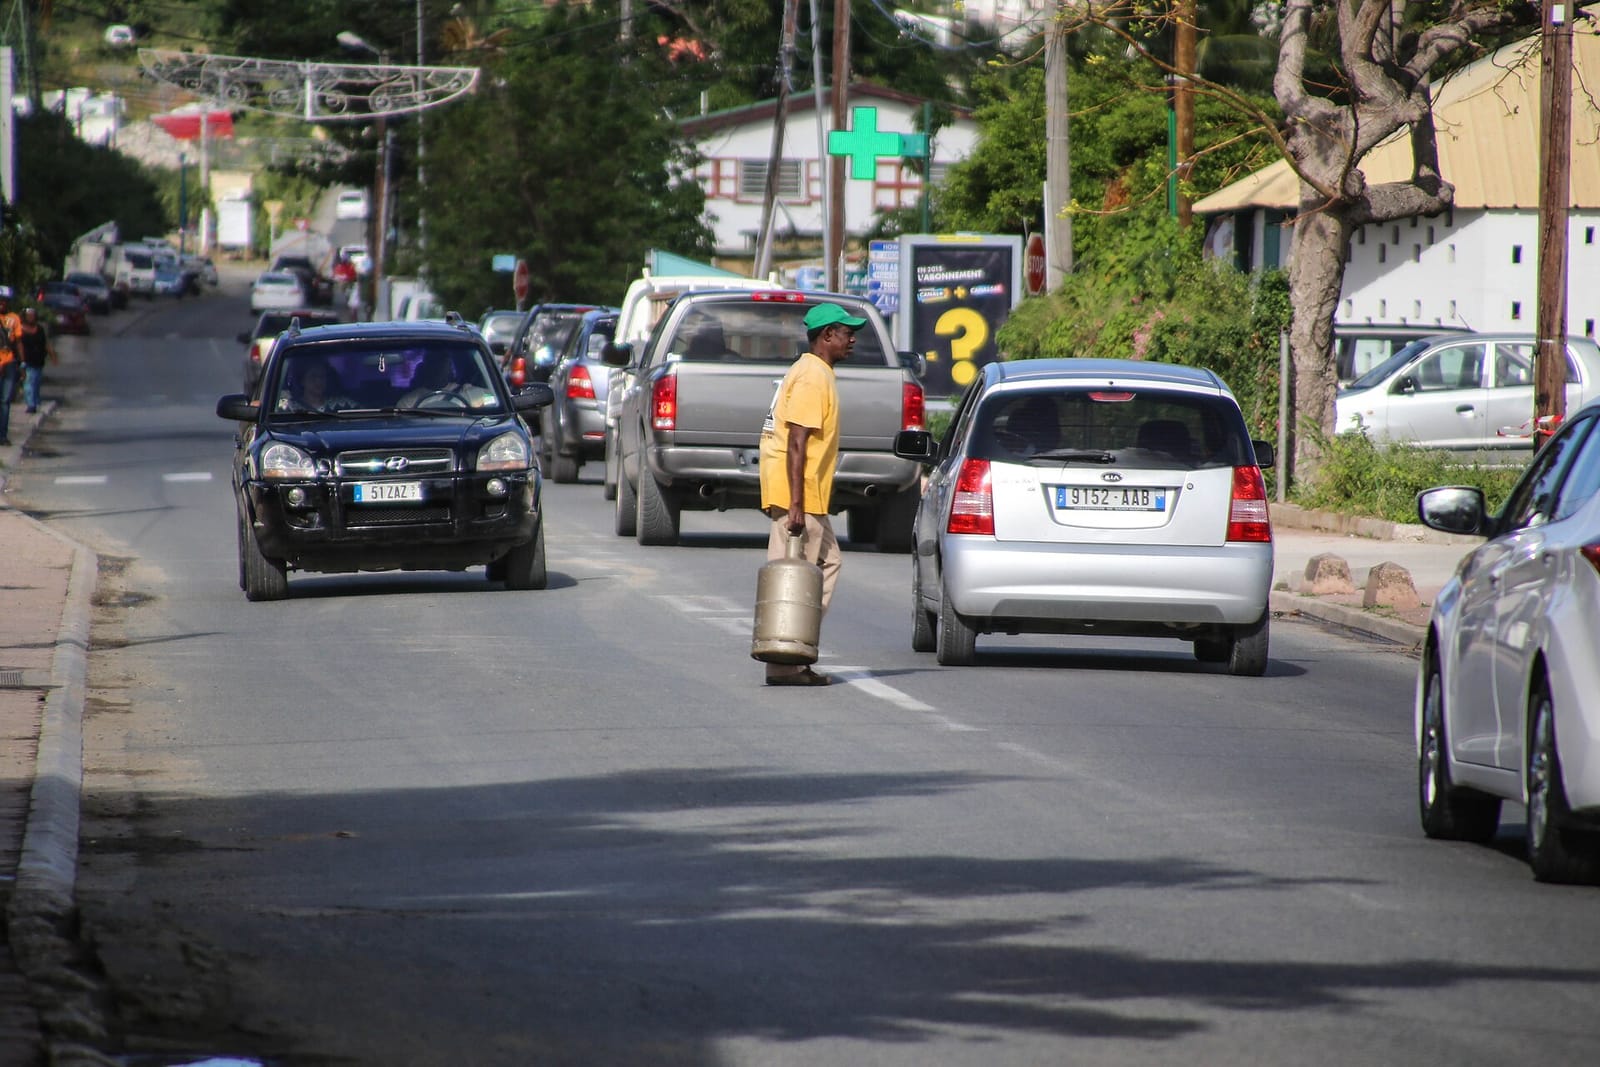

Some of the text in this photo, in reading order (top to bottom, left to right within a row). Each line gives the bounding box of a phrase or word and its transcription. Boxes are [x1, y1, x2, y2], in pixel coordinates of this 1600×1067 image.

[1028, 255, 1044, 273] STOP
[917, 269, 983, 281] L'ABONNEMENT
[934, 307, 989, 385] ?
